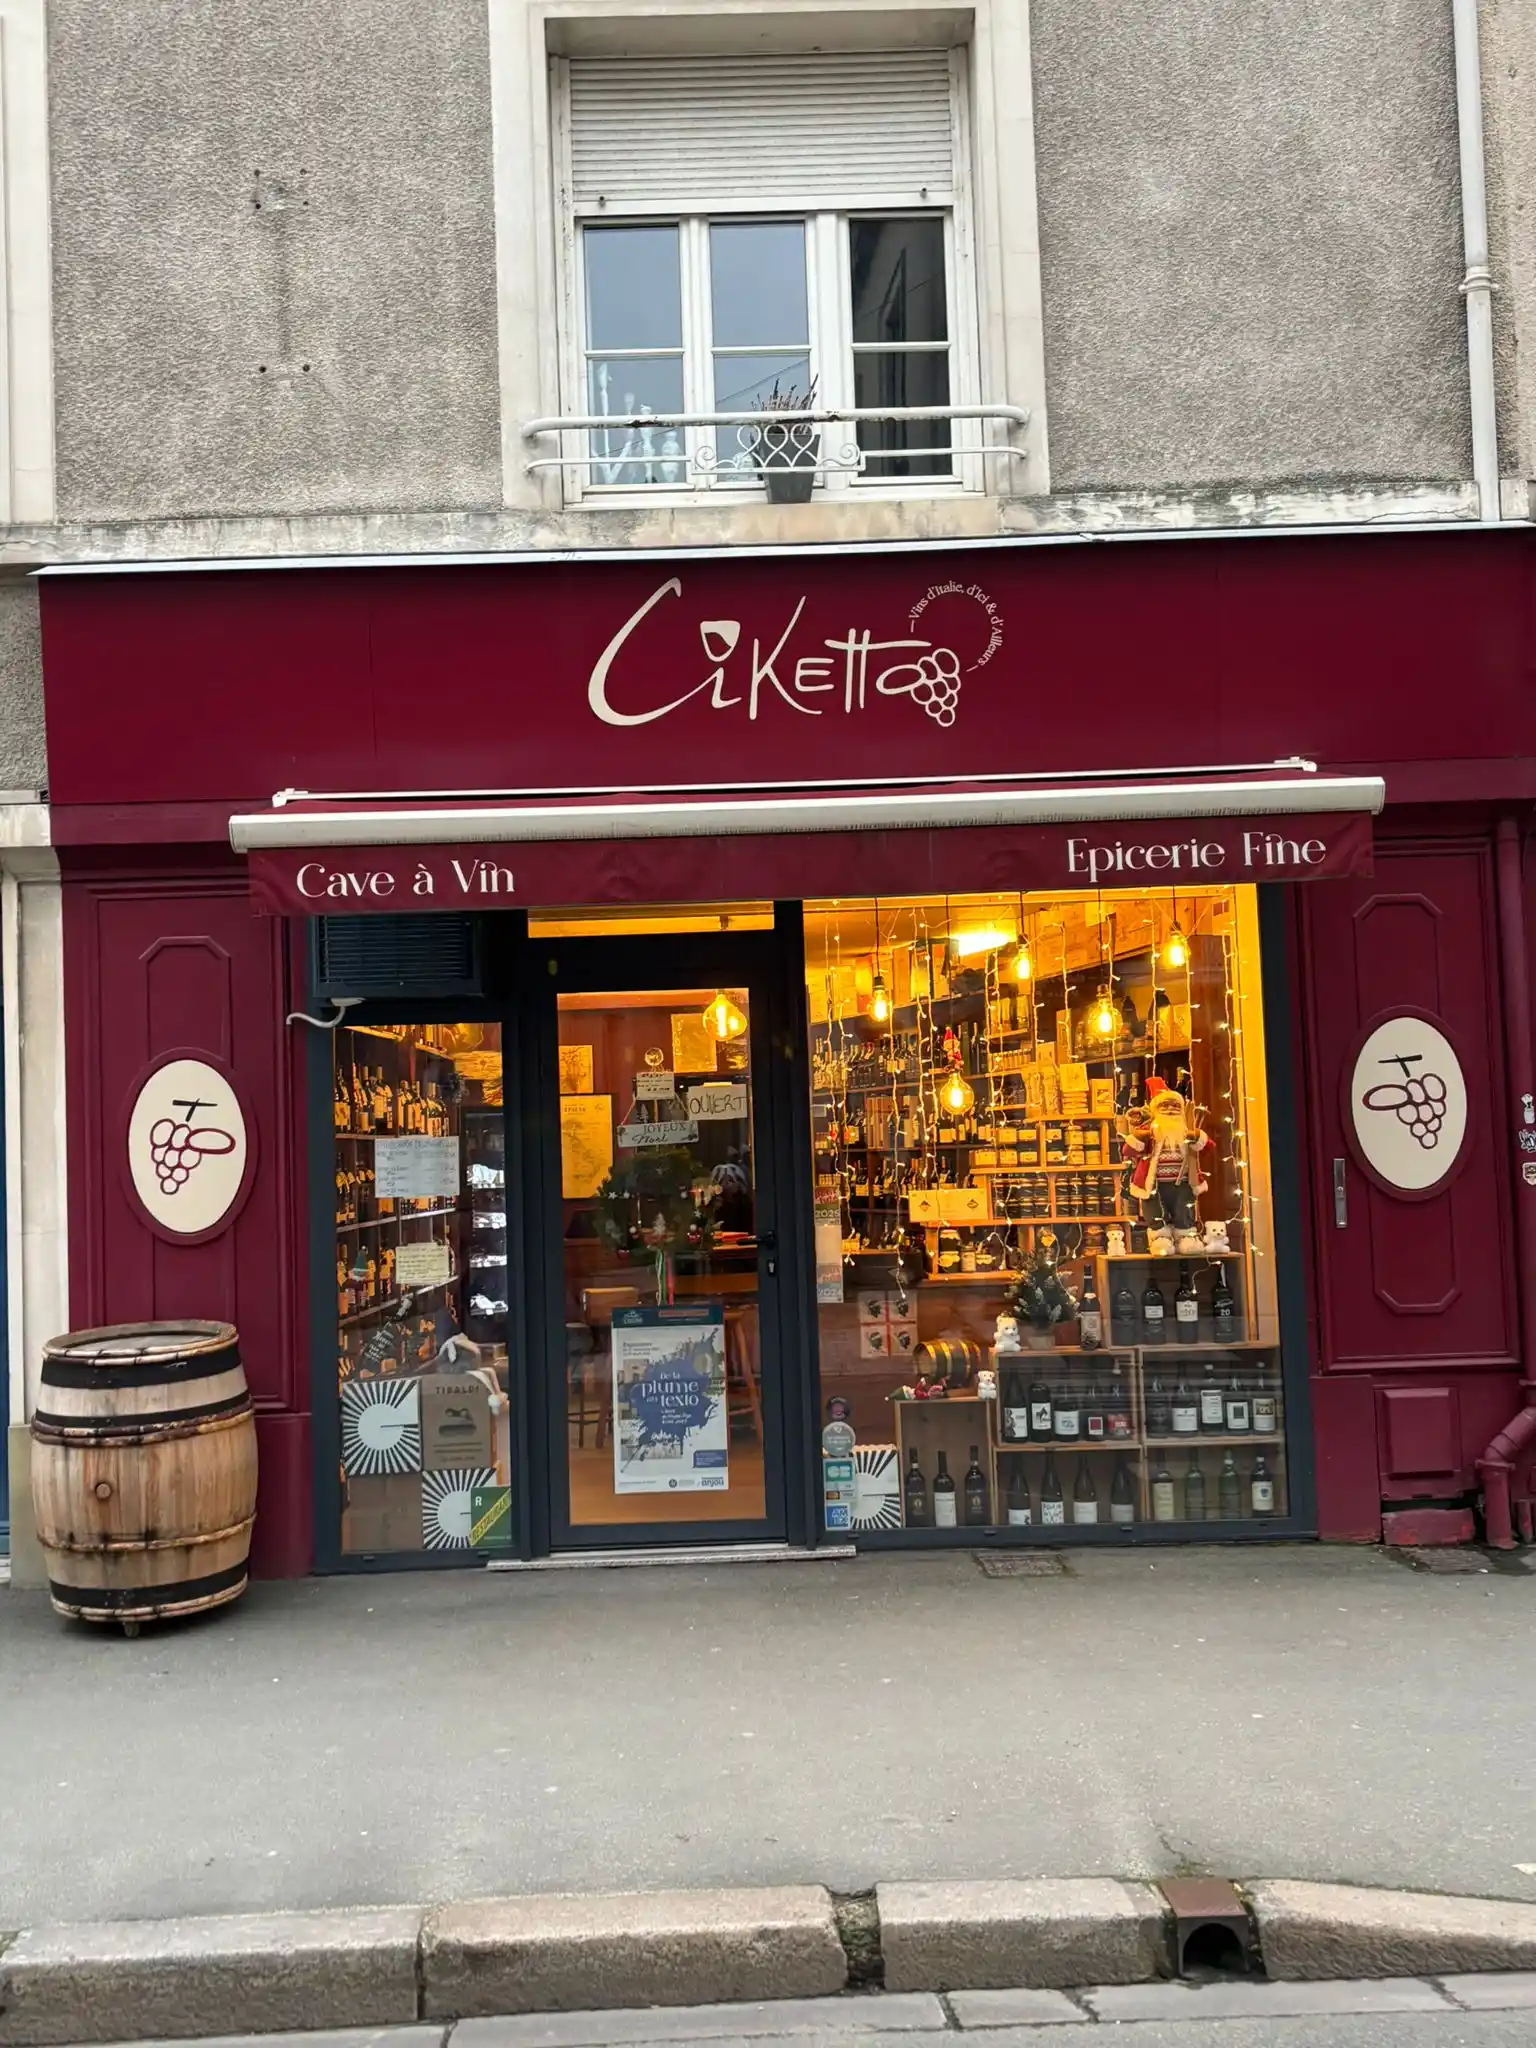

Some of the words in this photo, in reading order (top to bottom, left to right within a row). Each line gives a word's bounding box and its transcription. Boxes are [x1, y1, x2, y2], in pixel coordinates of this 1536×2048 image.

[908, 598, 929, 618] Vins
[966, 584, 991, 604] d'Ici
[985, 602, 997, 615] &
[1067, 838, 1225, 883] Epicerie
[1242, 831, 1327, 867] Fine
[296, 863, 395, 898] Cave
[412, 863, 434, 895] à
[450, 859, 515, 893] Vin
[689, 1092, 748, 1116] OUVERT
[642, 1379, 699, 1398] plume
[475, 1495, 483, 1507] R
